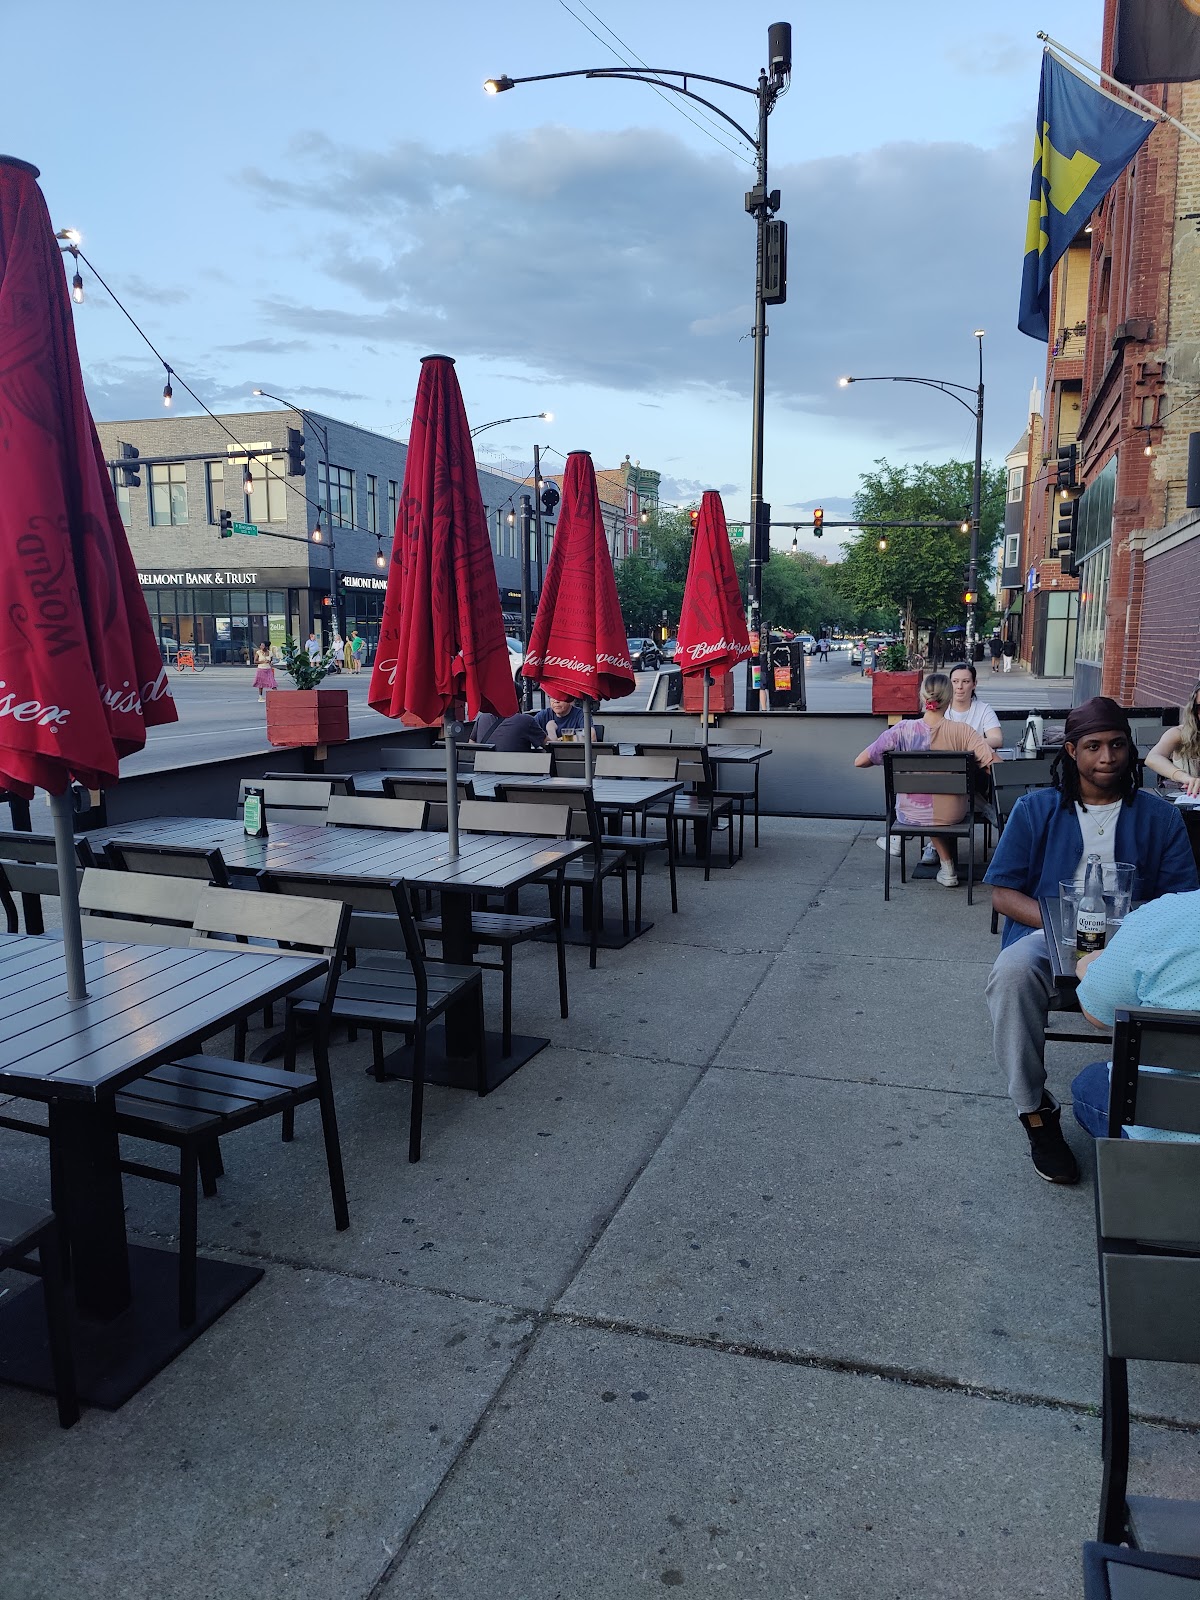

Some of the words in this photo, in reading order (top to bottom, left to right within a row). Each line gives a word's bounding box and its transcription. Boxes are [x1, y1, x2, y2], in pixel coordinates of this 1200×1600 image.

[138, 573, 184, 585] BELMONT
[185, 572, 213, 585] BANK
[214, 572, 224, 584] &
[224, 572, 257, 584] TRUST
[371, 578, 388, 590] BANK
[16, 532, 82, 658] WORLD
[1079, 917, 1104, 926] Corona
